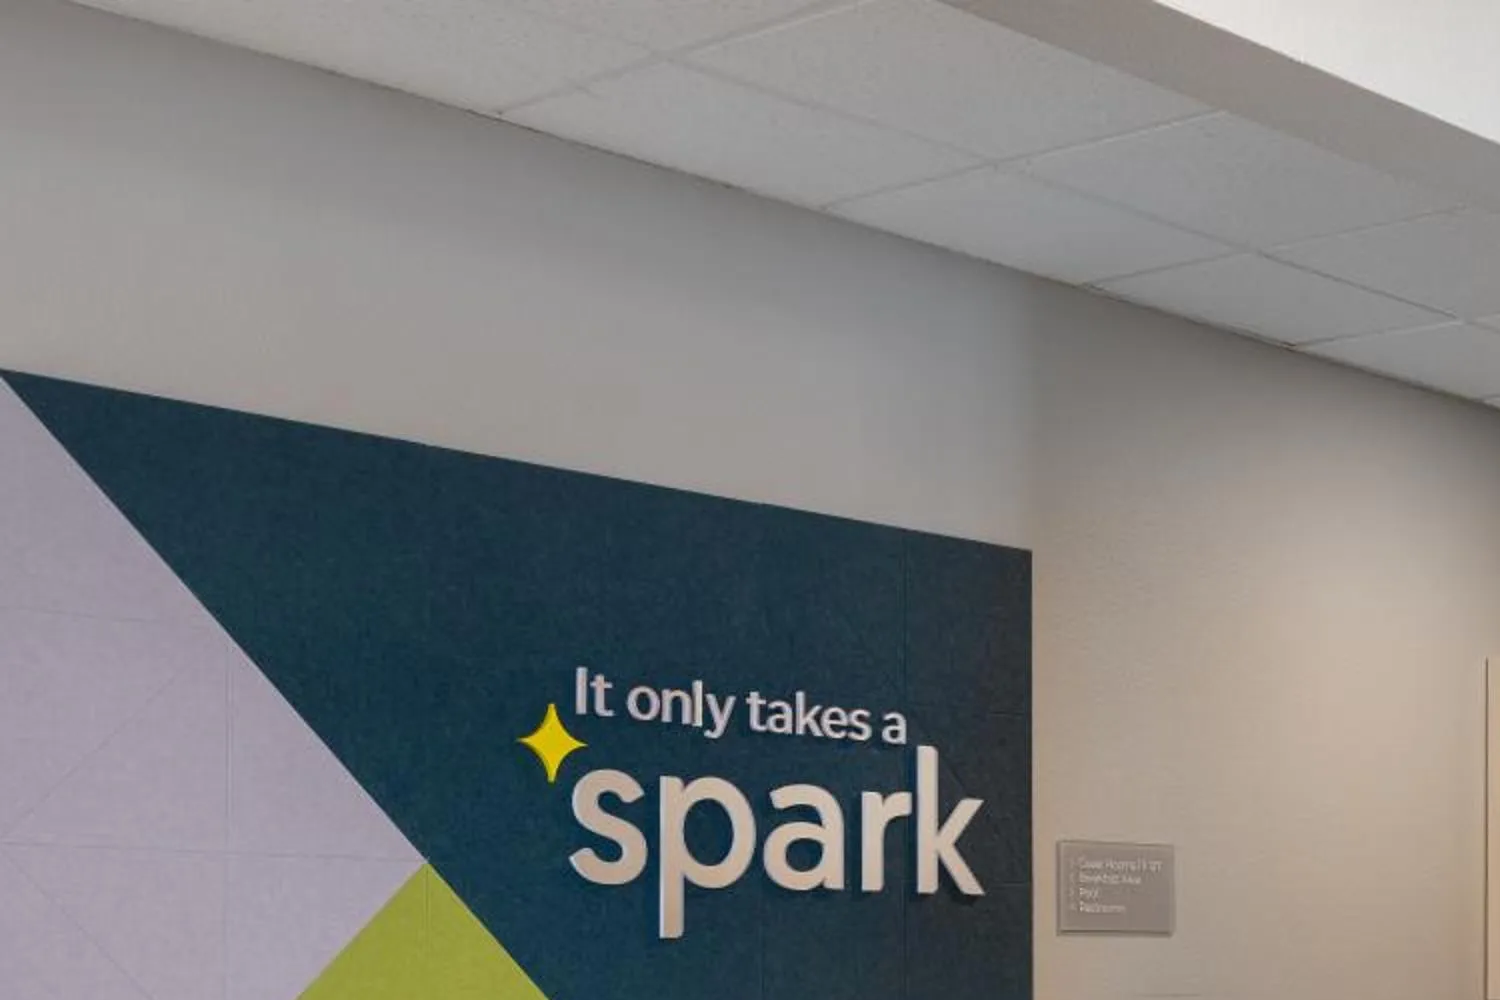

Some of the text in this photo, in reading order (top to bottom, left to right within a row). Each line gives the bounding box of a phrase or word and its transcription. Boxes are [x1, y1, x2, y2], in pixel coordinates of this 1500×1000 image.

[575, 666, 908, 745] It only takes a
[568, 745, 985, 939] spark
